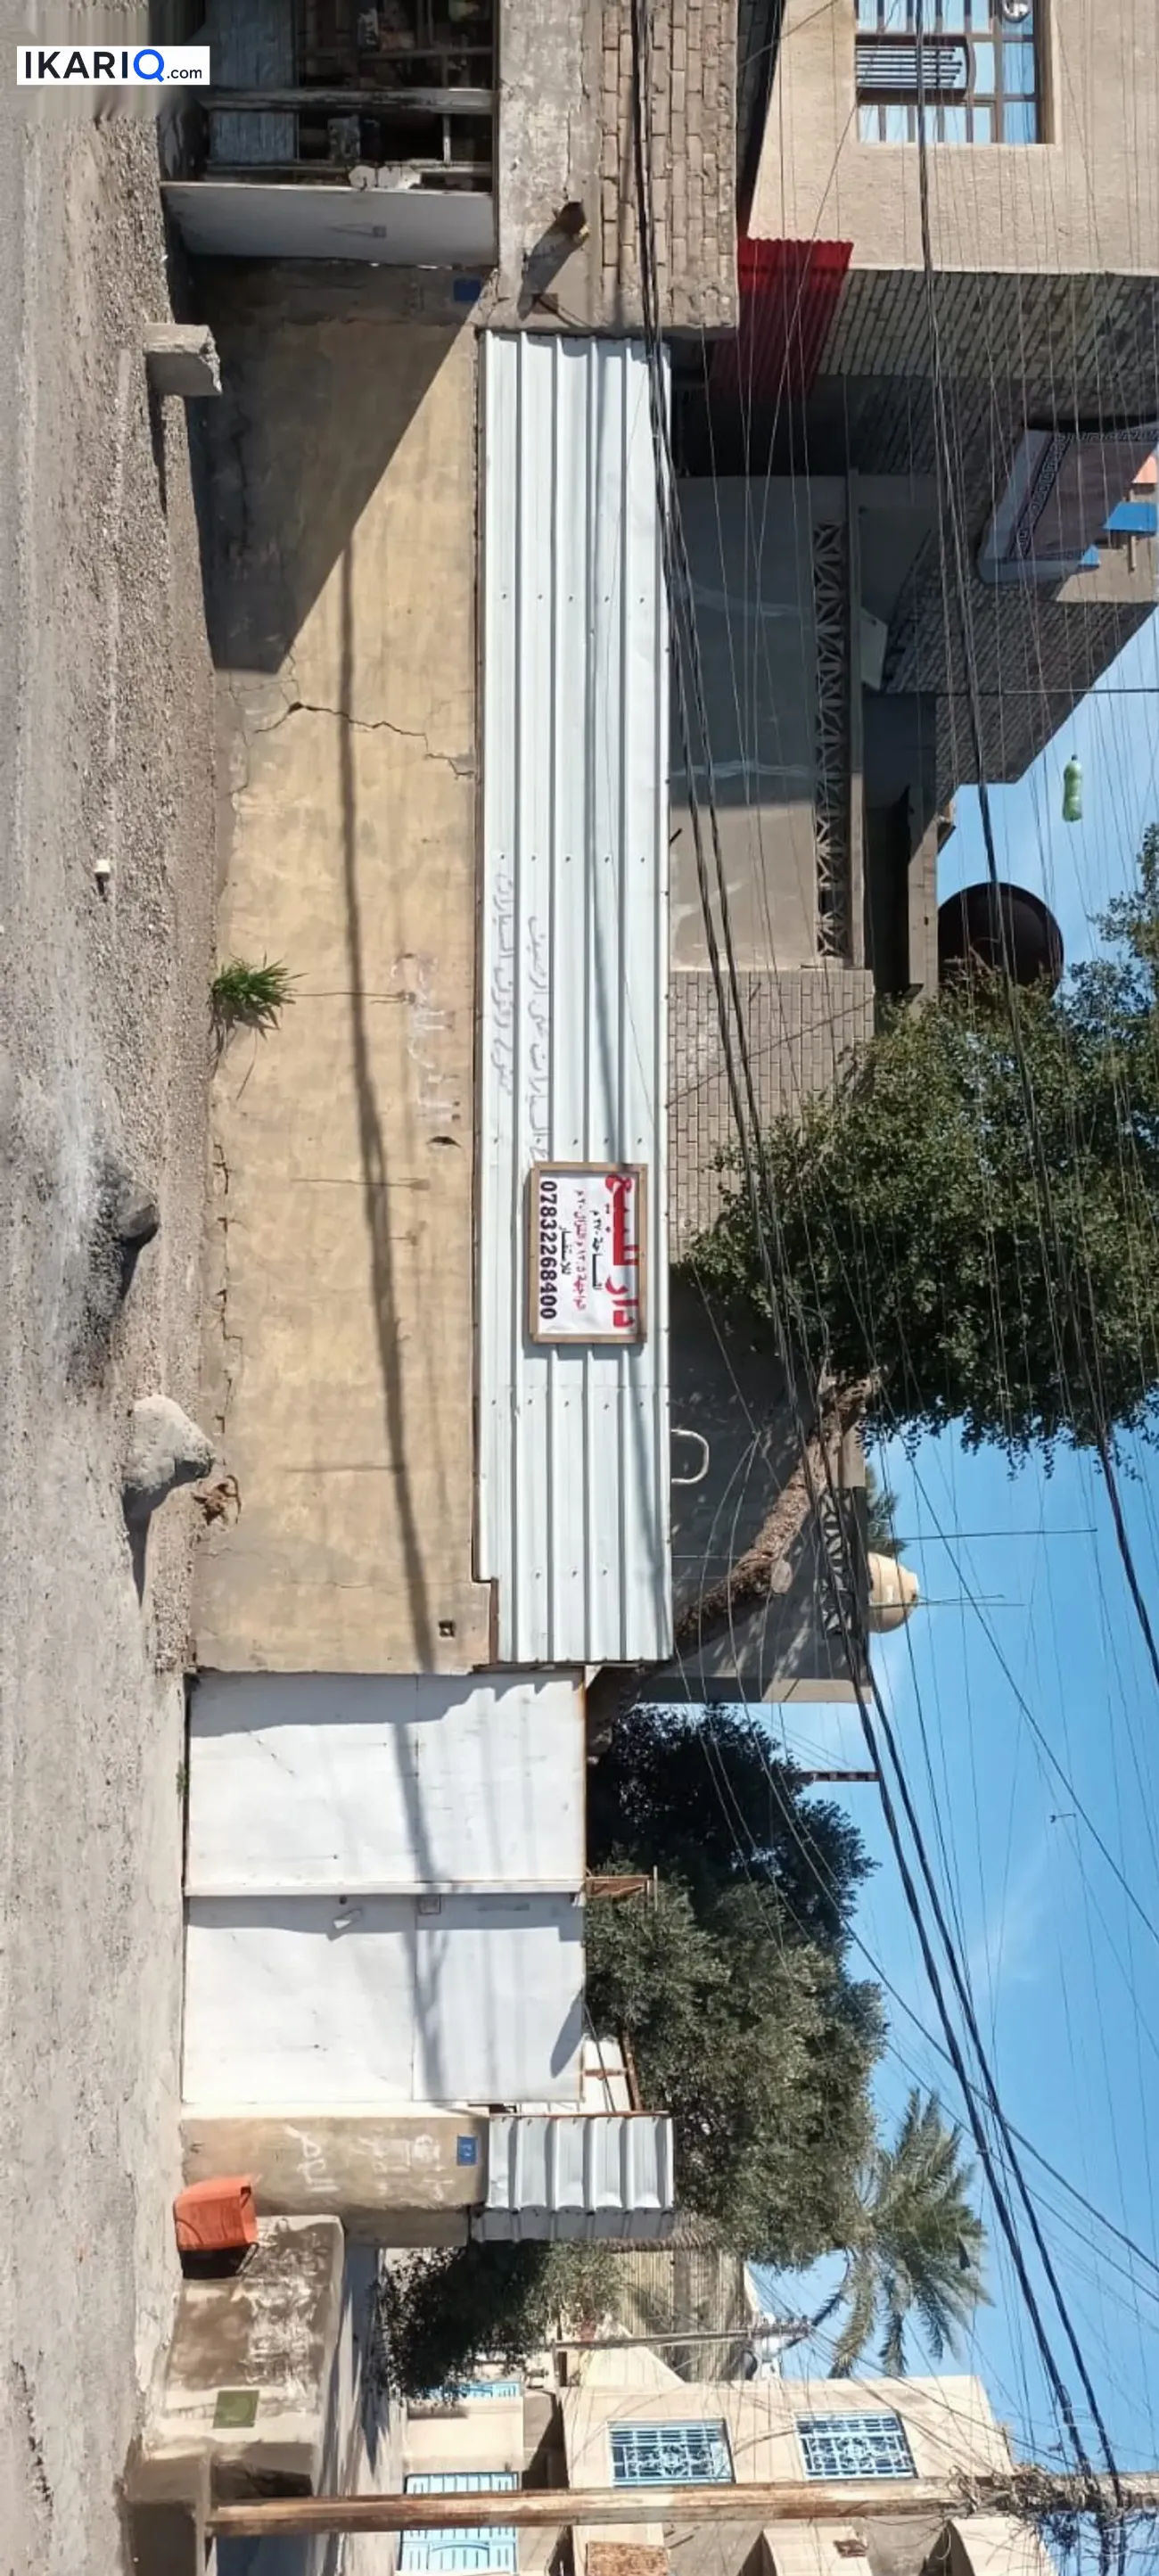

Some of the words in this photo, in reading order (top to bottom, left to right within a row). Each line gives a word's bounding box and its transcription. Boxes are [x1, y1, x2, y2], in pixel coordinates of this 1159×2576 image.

[540, 1181, 557, 1320] 07832268400
[559, 1226, 572, 1275] للاستفسار
[605, 1175, 639, 1266] للبيع
[605, 1276, 639, 1328] دار
